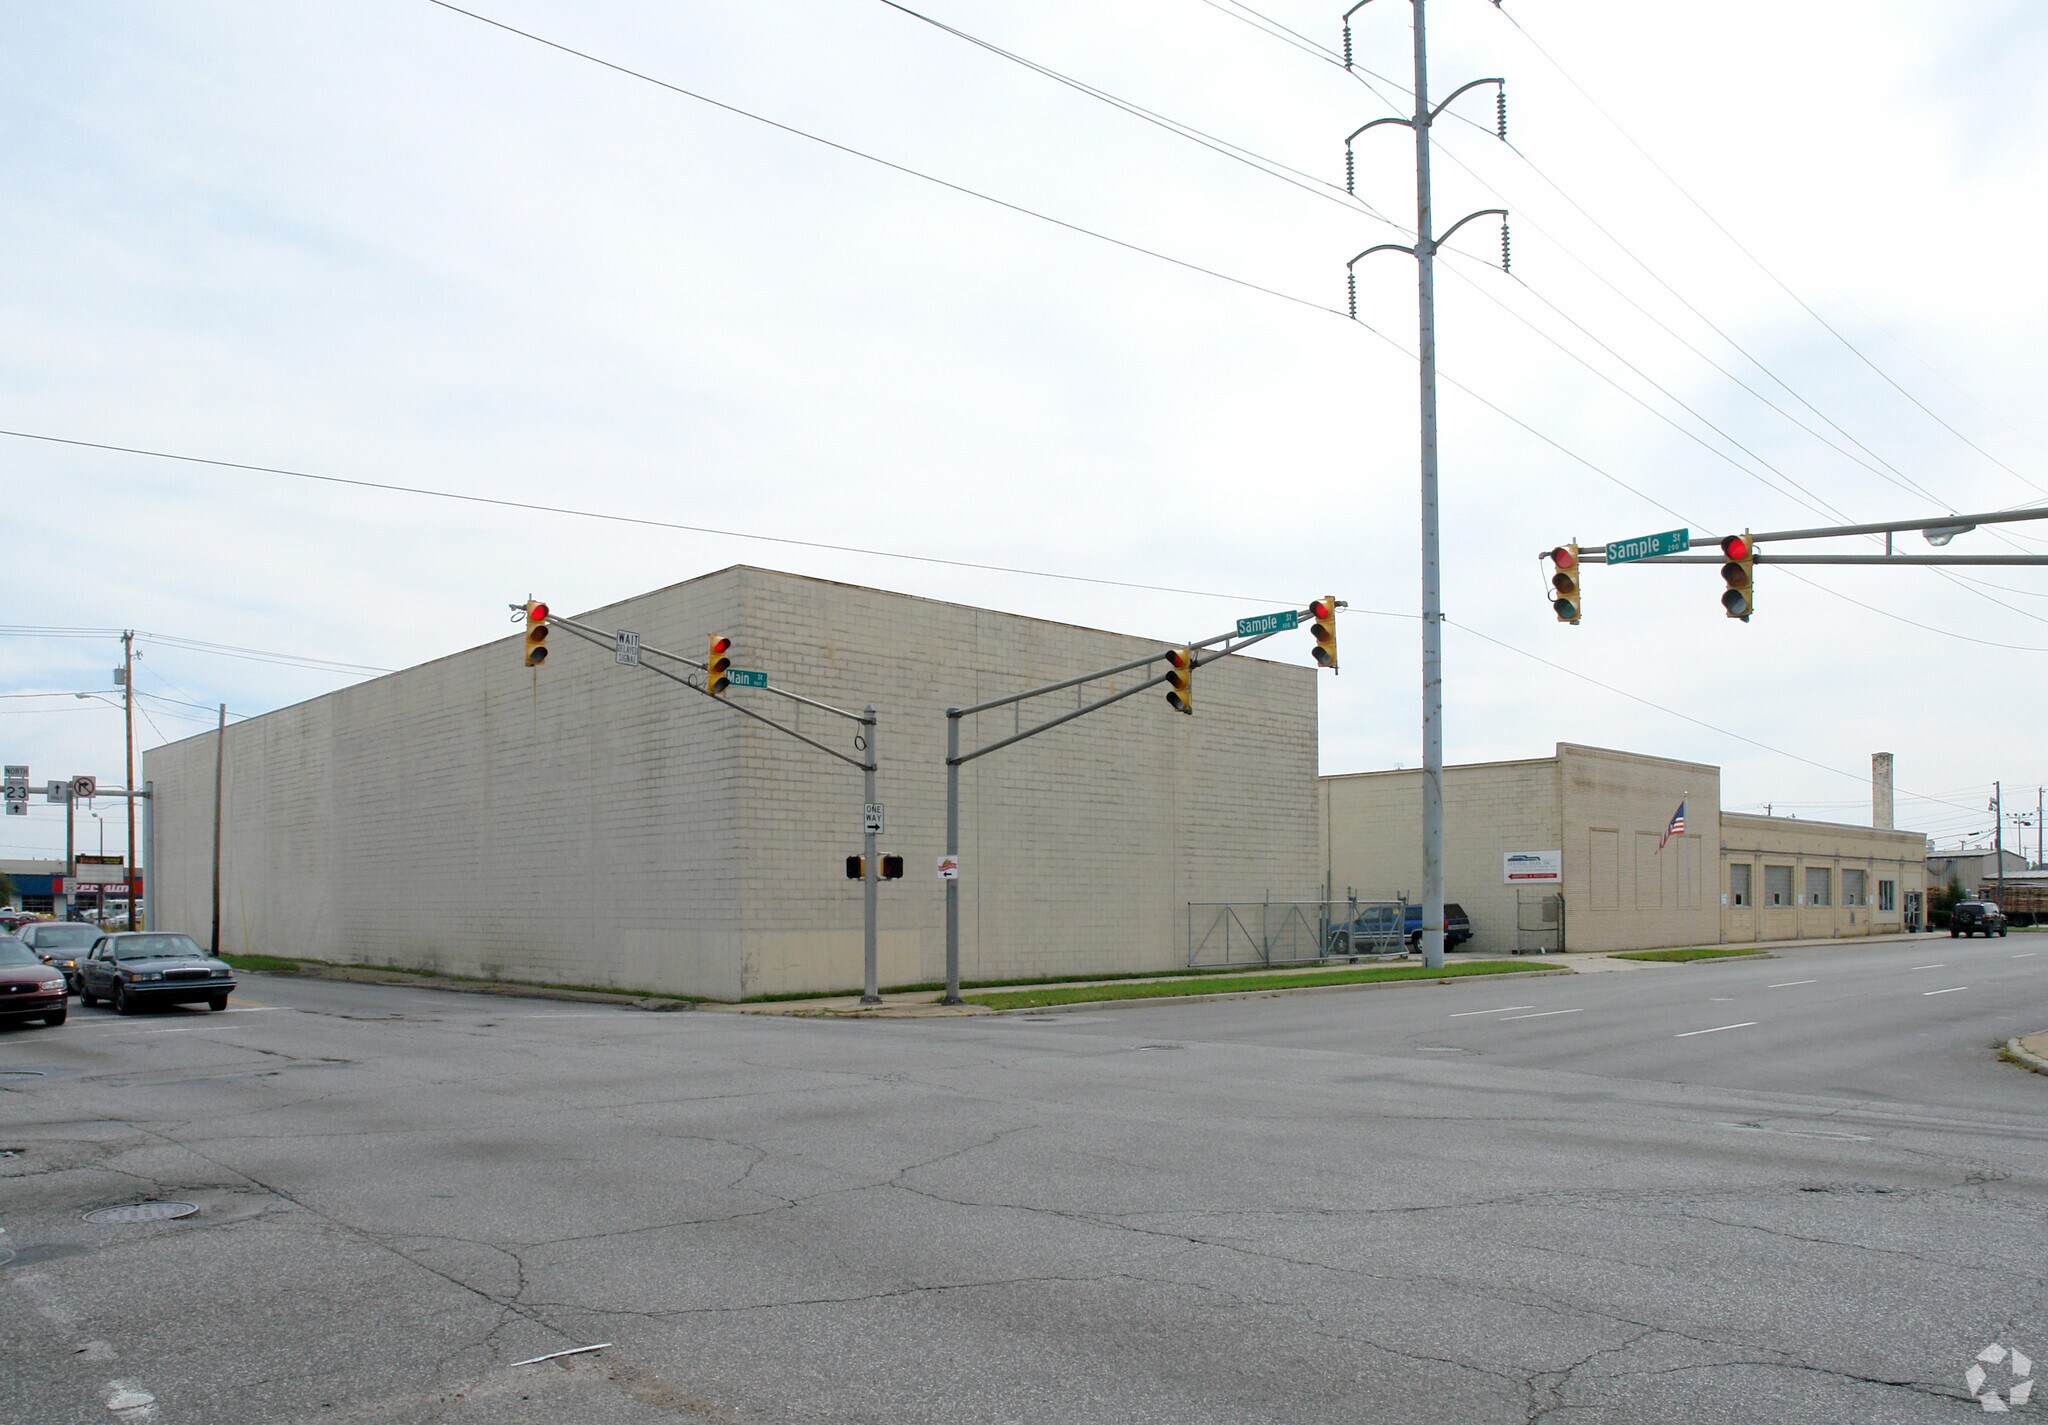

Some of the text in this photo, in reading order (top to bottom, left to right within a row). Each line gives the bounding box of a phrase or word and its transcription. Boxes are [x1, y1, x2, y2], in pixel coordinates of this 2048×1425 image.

[1608, 533, 1681, 561] Sample St
[1239, 613, 1292, 634] Sample St
[619, 632, 639, 646] WAIT
[727, 670, 764, 685] Main St
[5, 767, 28, 775] NORTH
[6, 786, 27, 799] 23
[866, 805, 881, 813] ONE
[865, 814, 882, 822] WAY
